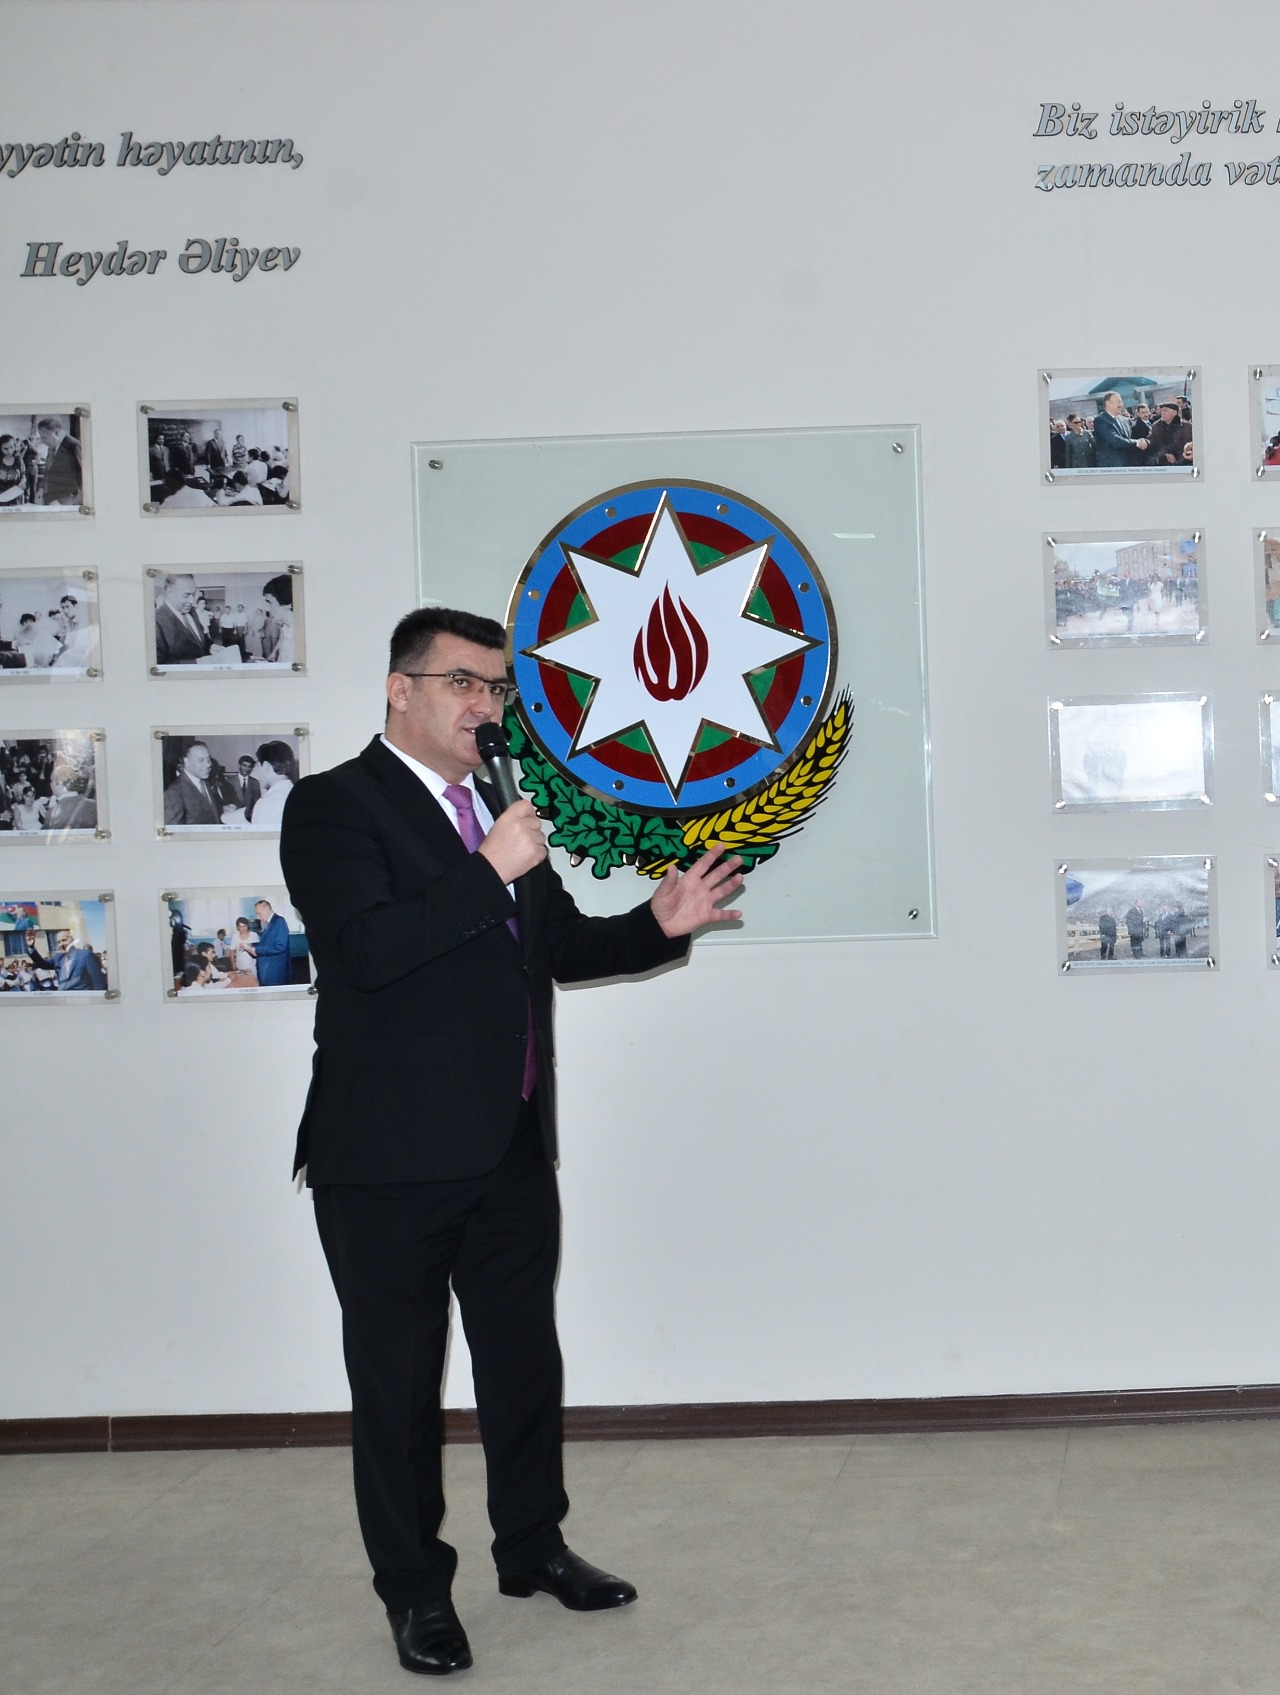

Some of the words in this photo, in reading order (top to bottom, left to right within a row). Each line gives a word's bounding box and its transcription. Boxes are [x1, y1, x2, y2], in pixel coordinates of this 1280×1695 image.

[1031, 102, 1100, 141] Biz
[1108, 98, 1267, 145] istəyirik
[115, 130, 304, 177] həyatının,
[1034, 151, 1213, 193] zamanda
[19, 239, 168, 287] Heydər
[177, 236, 302, 283] Əliyev
